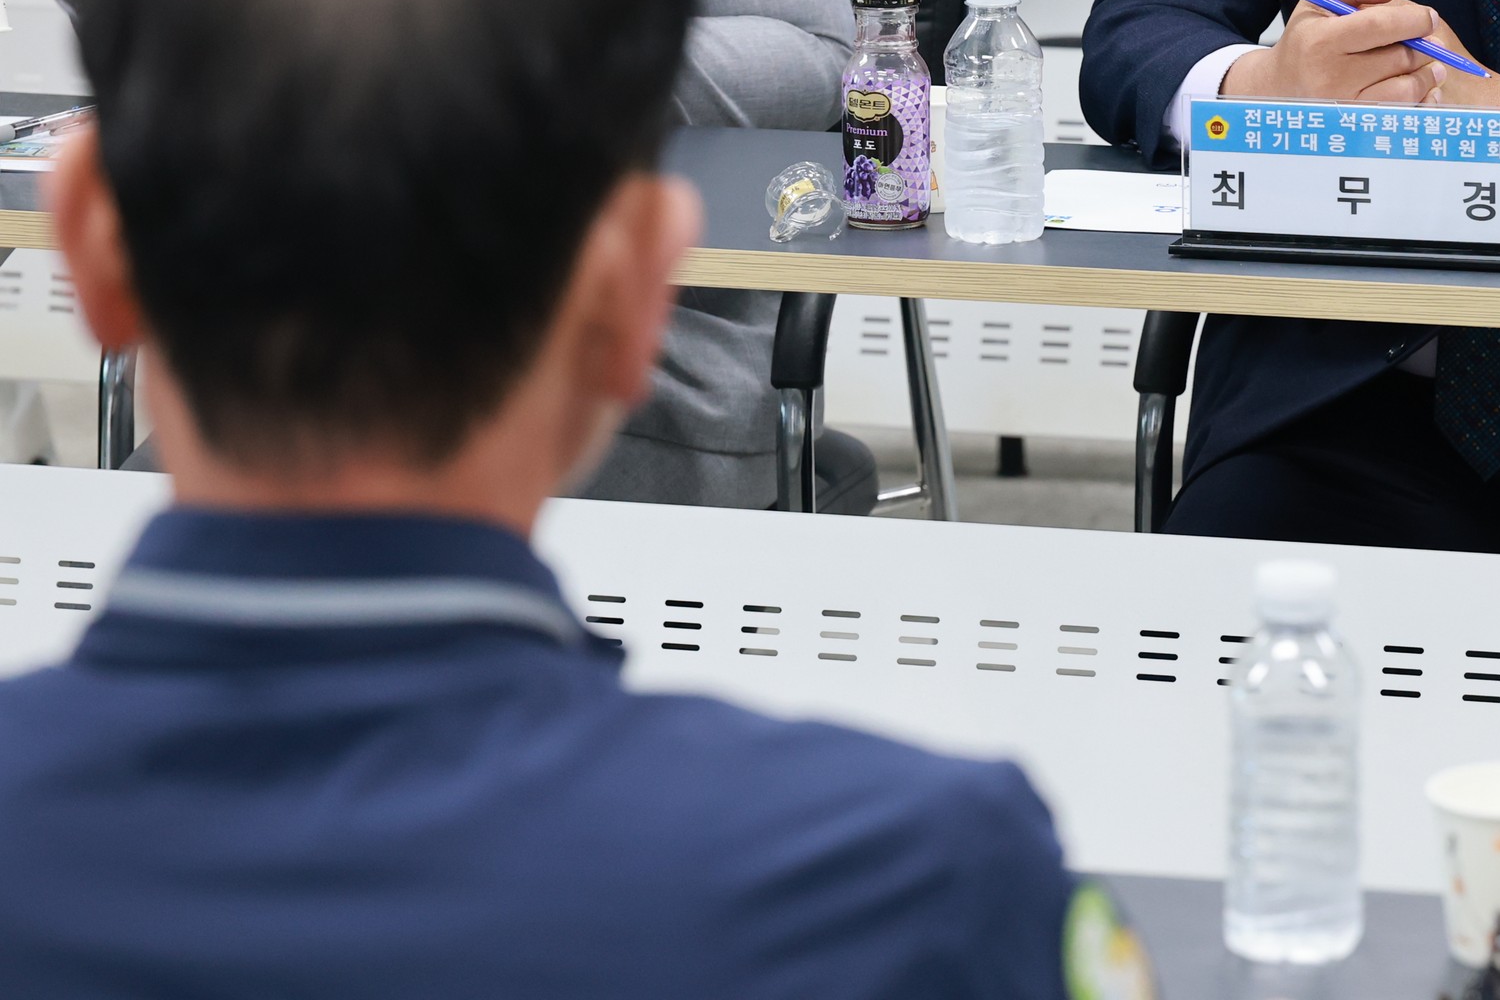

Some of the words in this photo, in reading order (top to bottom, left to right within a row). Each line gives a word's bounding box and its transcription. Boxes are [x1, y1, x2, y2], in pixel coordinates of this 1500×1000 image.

[1244, 108, 1326, 130] 전라남도
[846, 122, 888, 137] Premium
[853, 138, 877, 151] 포도
[1244, 130, 1347, 154] 위기대응
